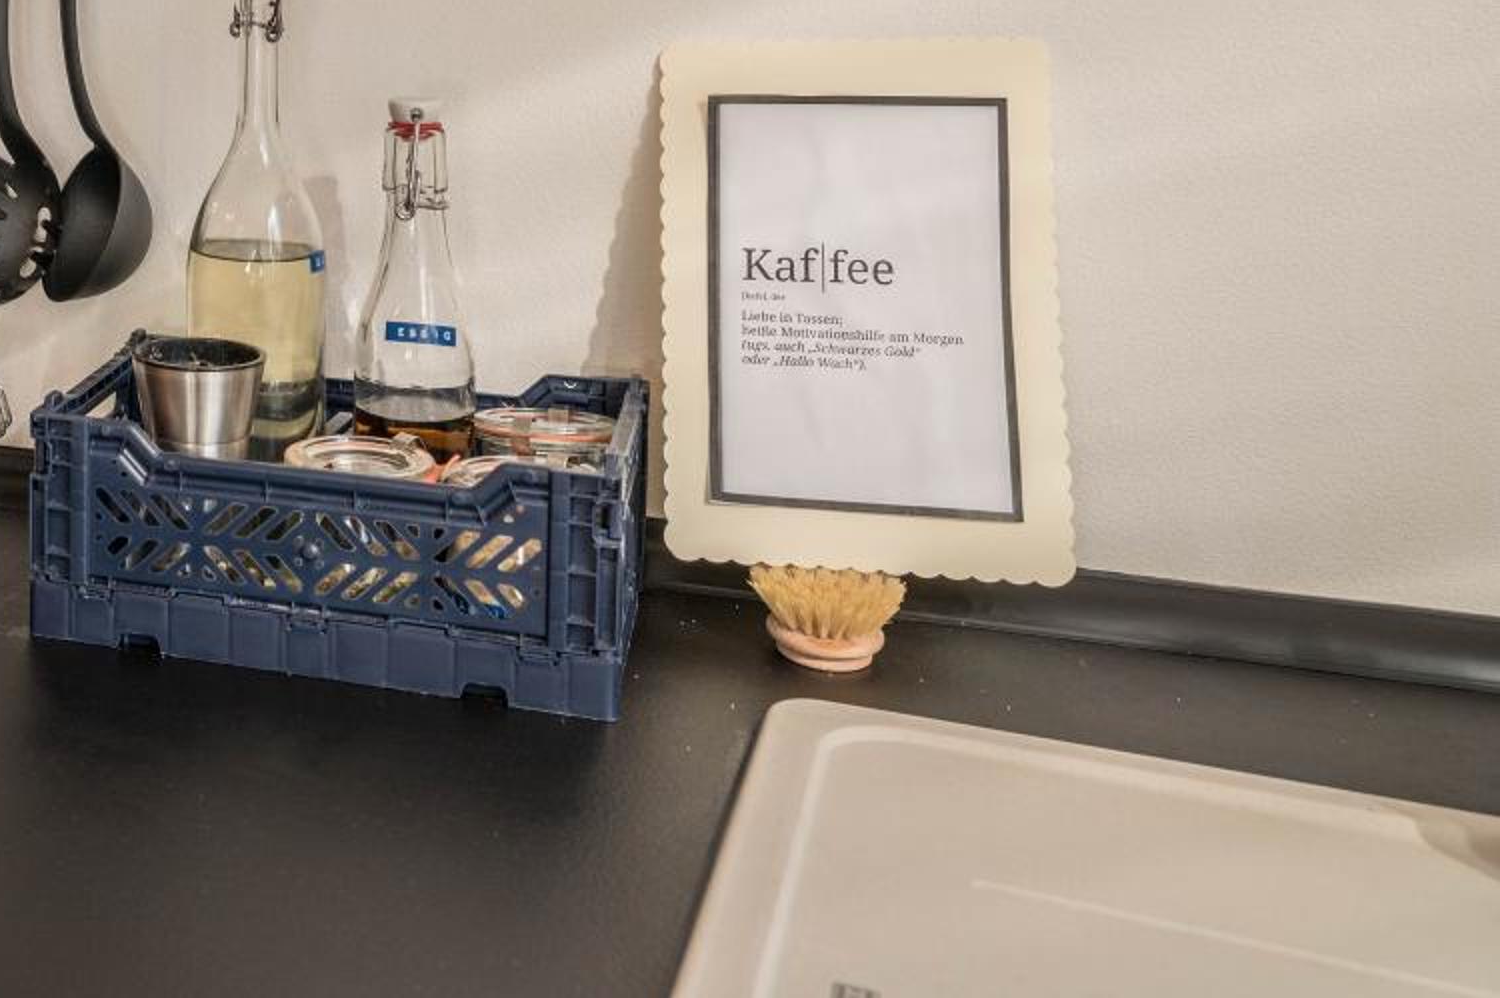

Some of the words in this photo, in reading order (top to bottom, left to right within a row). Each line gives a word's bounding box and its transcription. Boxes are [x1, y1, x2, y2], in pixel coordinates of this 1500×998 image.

[741, 310, 777, 323] Liebe
[779, 312, 793, 323] in
[781, 326, 885, 342] Motivationshilfe
[889, 333, 909, 343] am
[913, 332, 964, 347] Morgen
[774, 342, 805, 353] auch
[741, 354, 771, 365] oder
